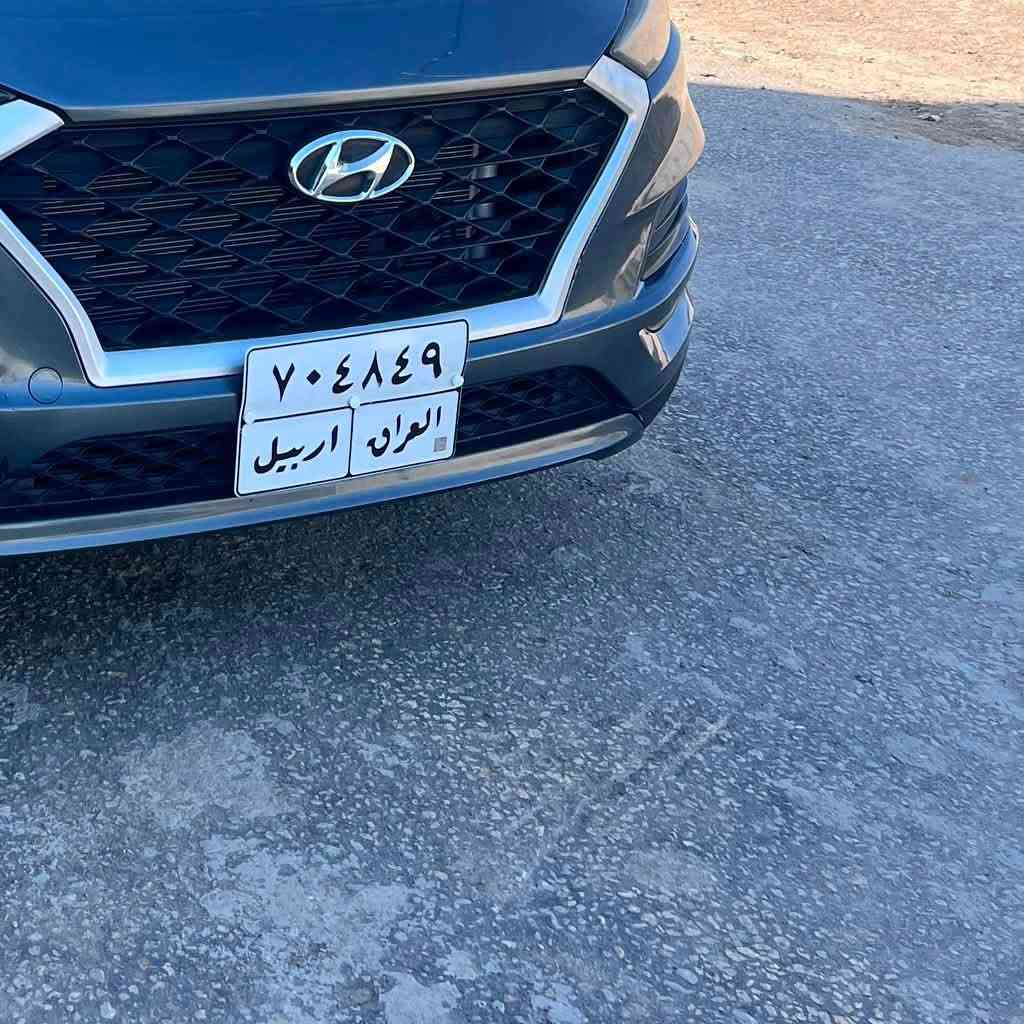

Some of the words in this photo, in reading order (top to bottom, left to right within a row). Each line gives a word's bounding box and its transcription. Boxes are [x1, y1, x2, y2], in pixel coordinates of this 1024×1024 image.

[272, 341, 443, 403] ٧٠٤٨٤٩
[253, 424, 339, 474] اربيل
[366, 405, 443, 457] العراق
